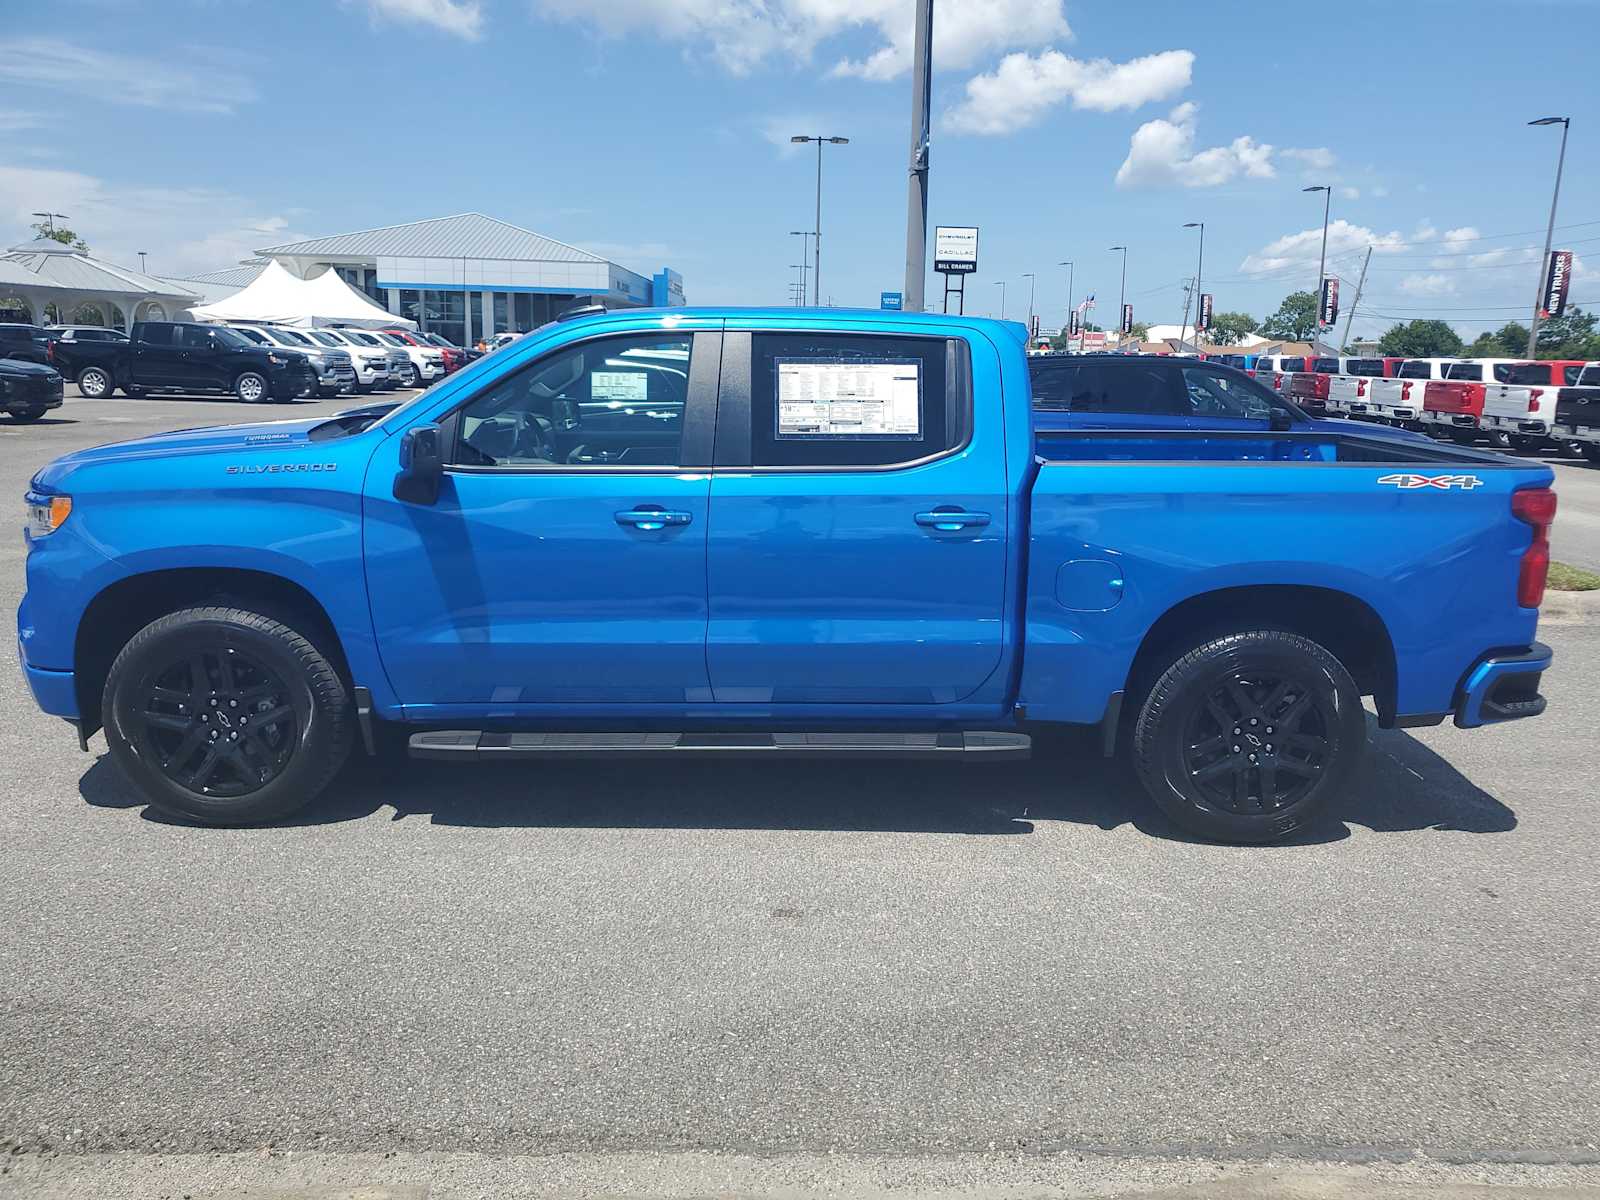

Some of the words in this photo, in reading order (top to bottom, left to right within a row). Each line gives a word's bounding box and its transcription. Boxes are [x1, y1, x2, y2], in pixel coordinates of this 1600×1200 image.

[1552, 255, 1565, 291] TRUCKS
[1548, 293, 1560, 314] NEW
[226, 463, 337, 474] SILVERADO
